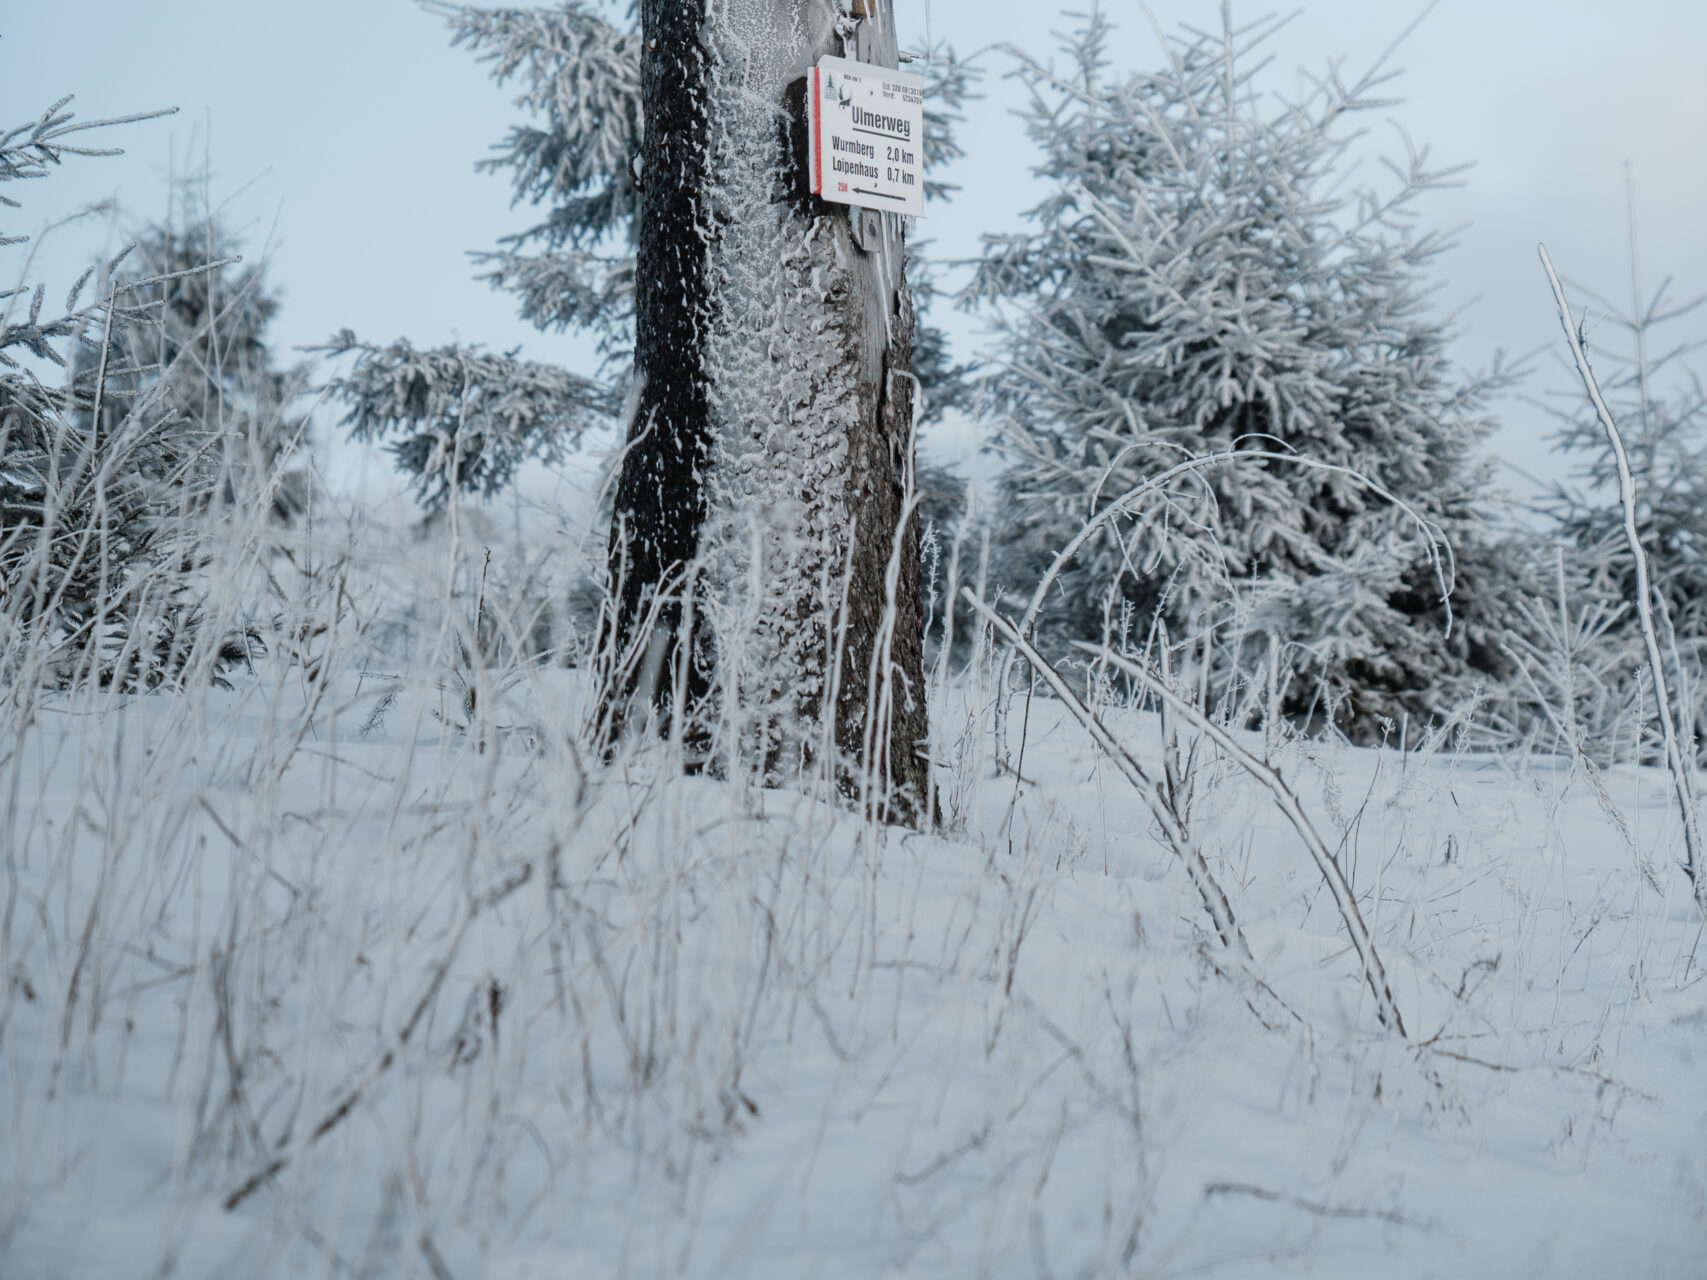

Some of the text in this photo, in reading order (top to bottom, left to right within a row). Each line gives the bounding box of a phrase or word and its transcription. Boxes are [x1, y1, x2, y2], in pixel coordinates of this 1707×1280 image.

[851, 105, 911, 137] Ulmerweg
[832, 135, 914, 165] Wurmberg 2,0 km
[832, 156, 915, 185] Loipenhaus 0,7 km
